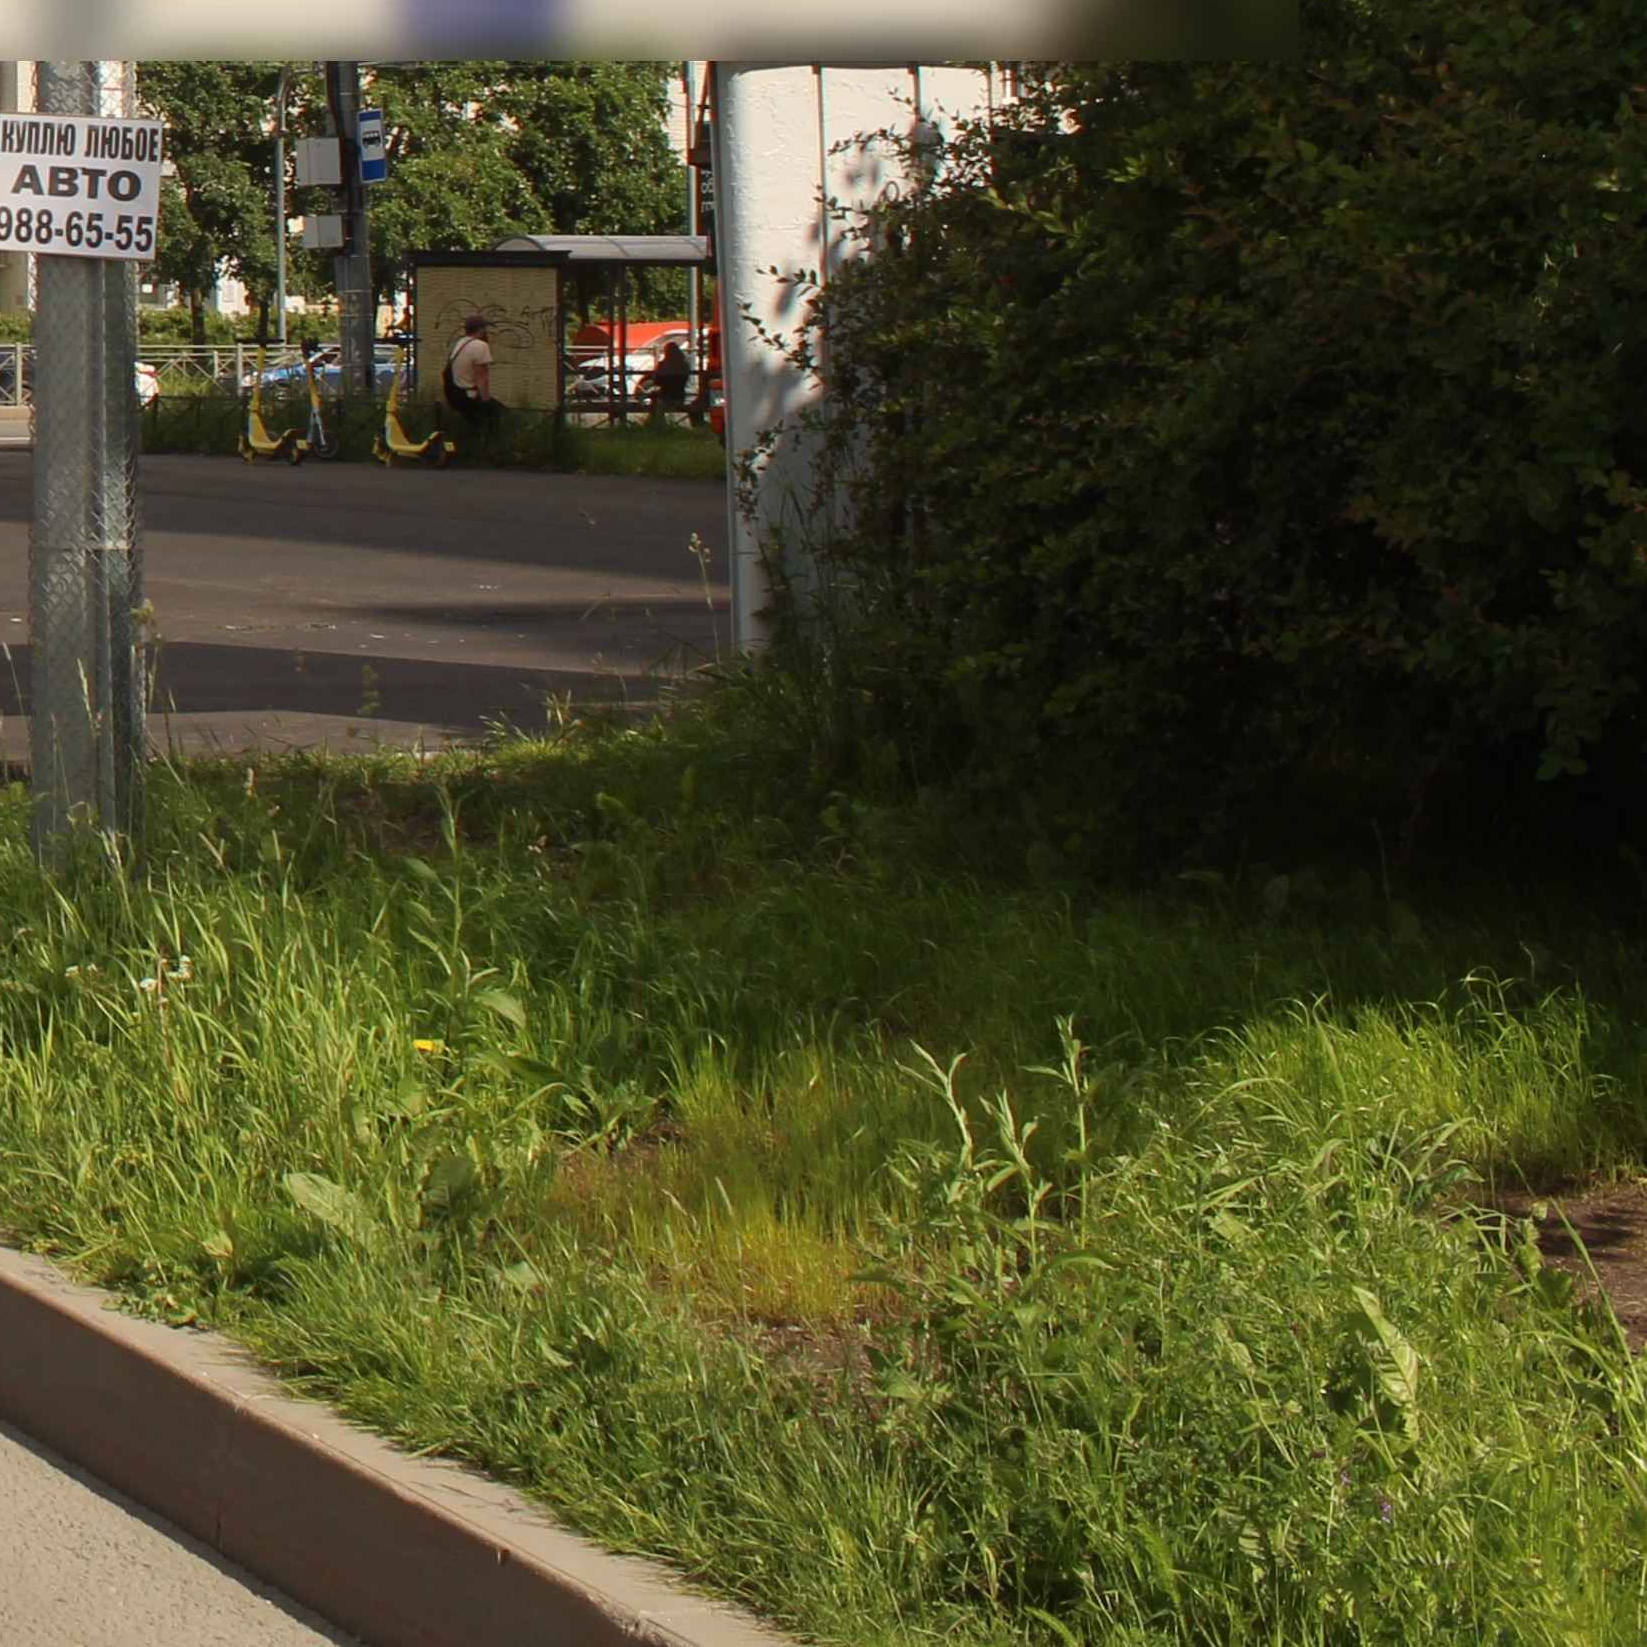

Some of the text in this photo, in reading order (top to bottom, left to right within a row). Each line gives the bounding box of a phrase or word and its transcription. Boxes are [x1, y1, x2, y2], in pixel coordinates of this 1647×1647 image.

[0, 119, 159, 163] КУПЛЮ ЛЮБОЕ
[10, 164, 143, 202] АВТО
